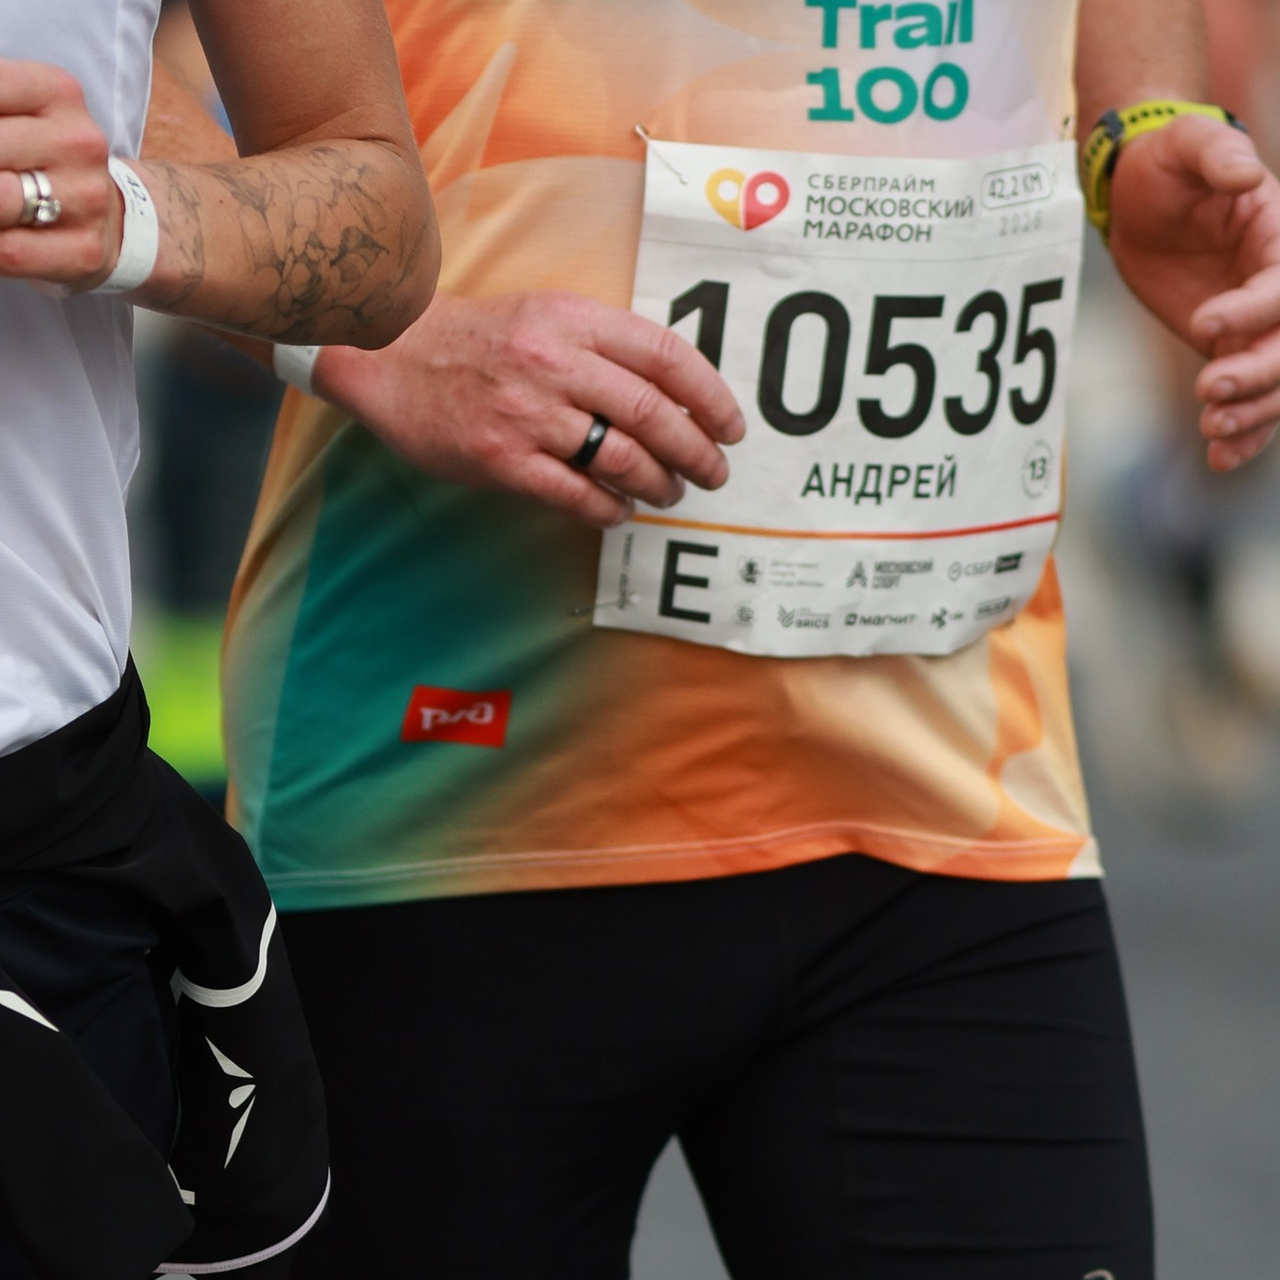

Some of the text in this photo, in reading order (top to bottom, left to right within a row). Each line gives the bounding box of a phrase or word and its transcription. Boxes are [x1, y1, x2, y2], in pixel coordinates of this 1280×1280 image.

[805, 61, 970, 125] 100
[806, 173, 936, 193] СБЕРПРАЙМ
[805, 194, 974, 219] МОСКОВСКИЙ
[803, 218, 933, 244] МАРАФОН
[666, 276, 1065, 440] 10535
[800, 453, 958, 506] АНДРЕЙ
[1028, 456, 1048, 481] 13
[658, 539, 719, 624] E
